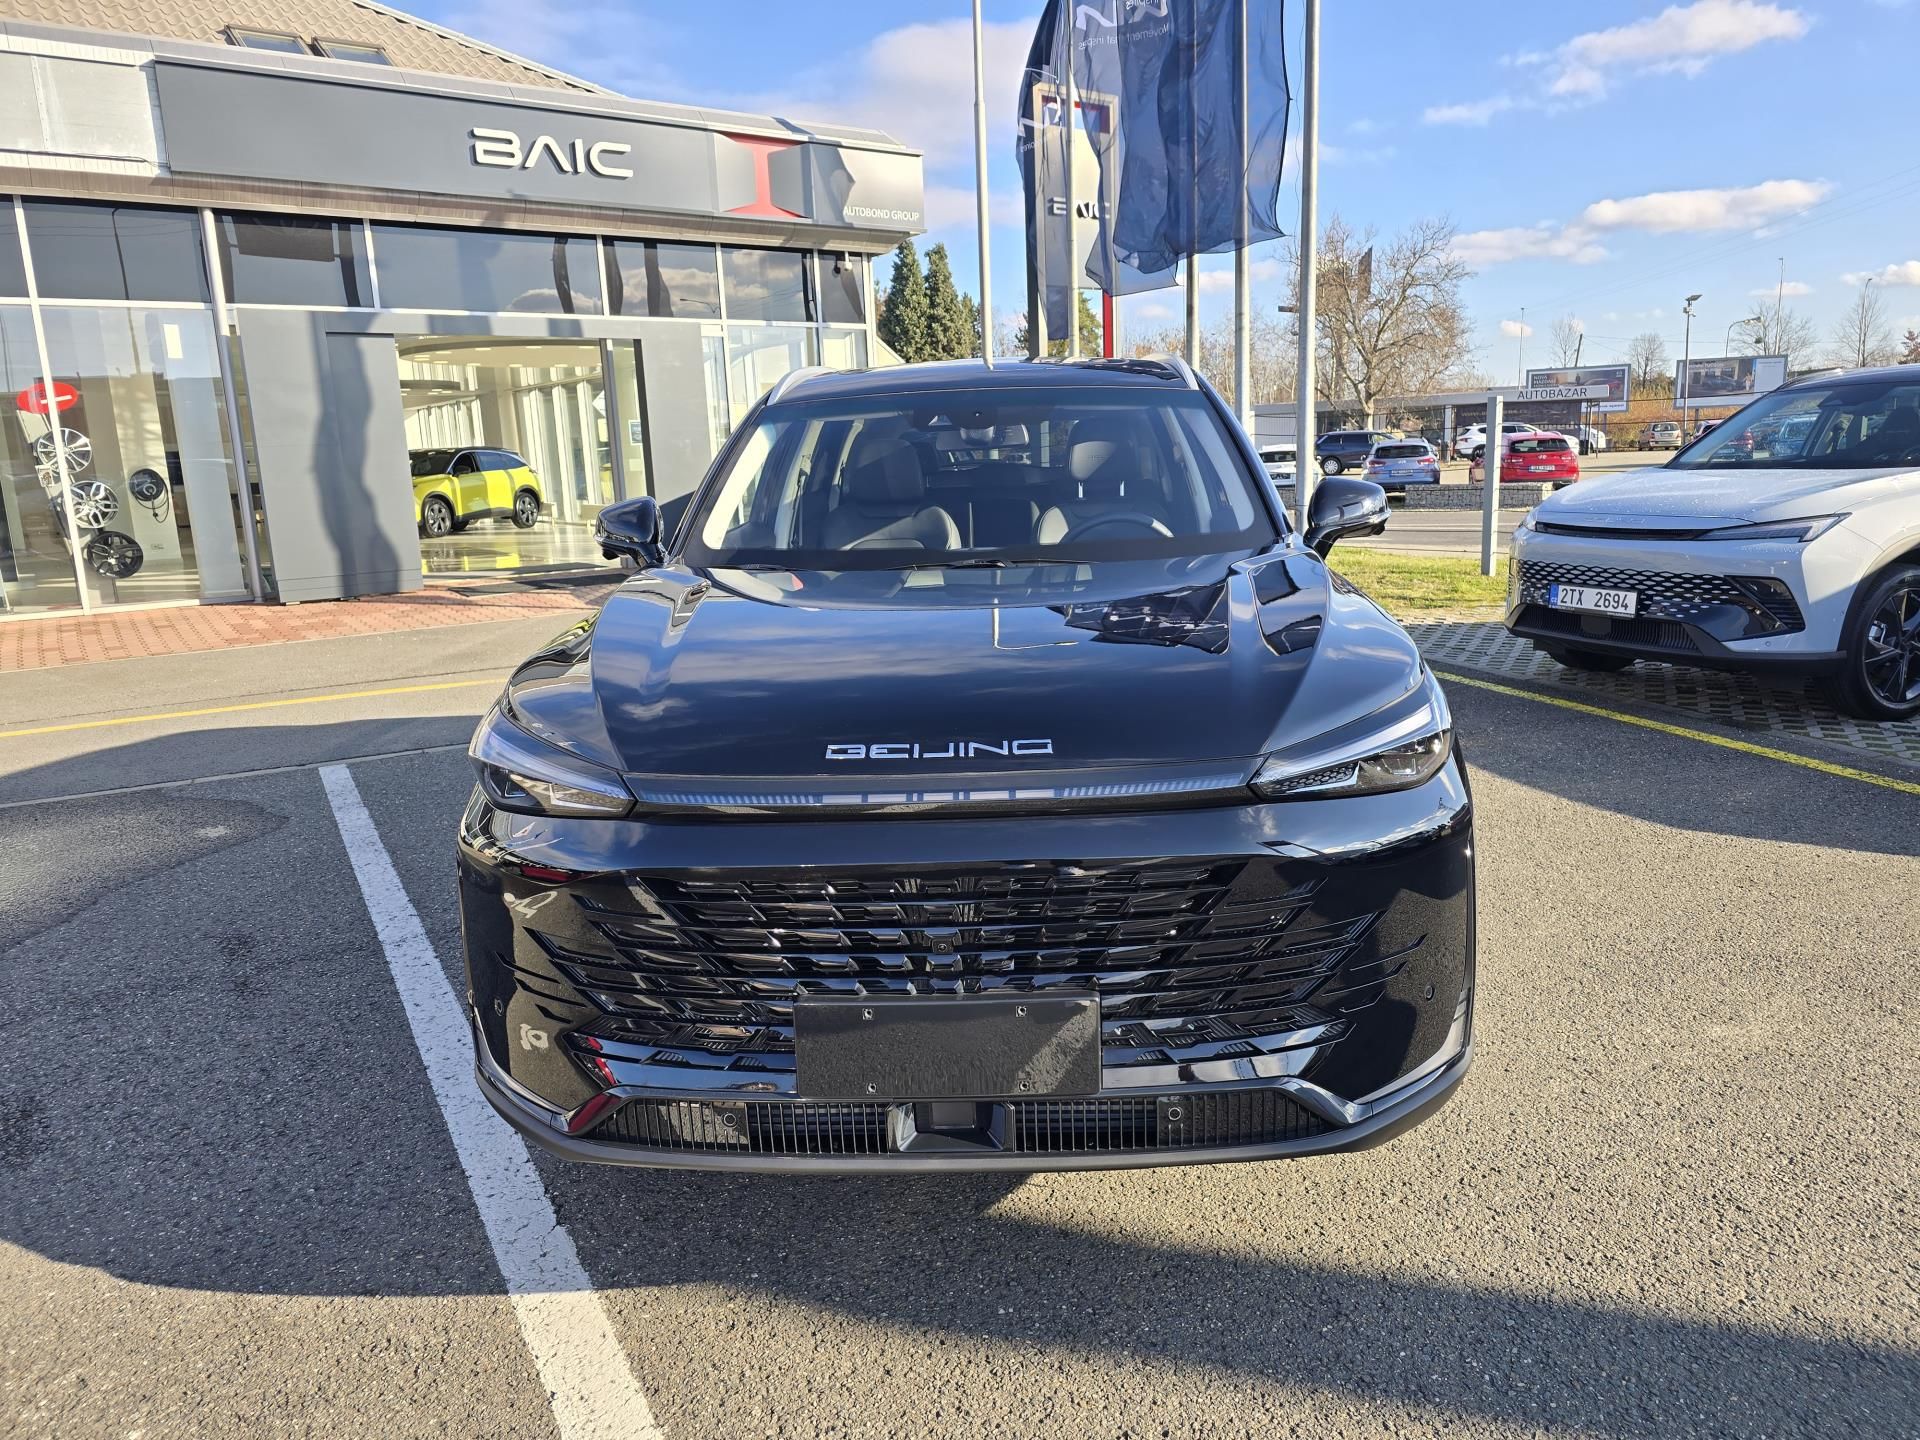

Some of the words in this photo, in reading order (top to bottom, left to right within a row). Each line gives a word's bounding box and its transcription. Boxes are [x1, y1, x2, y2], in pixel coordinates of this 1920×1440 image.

[471, 127, 633, 178] BAIC
[843, 205, 890, 219] AUTOBOND
[891, 210, 919, 221] GROUP
[1517, 387, 1587, 400] AUTOBAZAR
[1560, 588, 1584, 606] 2TX
[1594, 592, 1629, 611] 2694
[826, 738, 1053, 759] BEIJING
